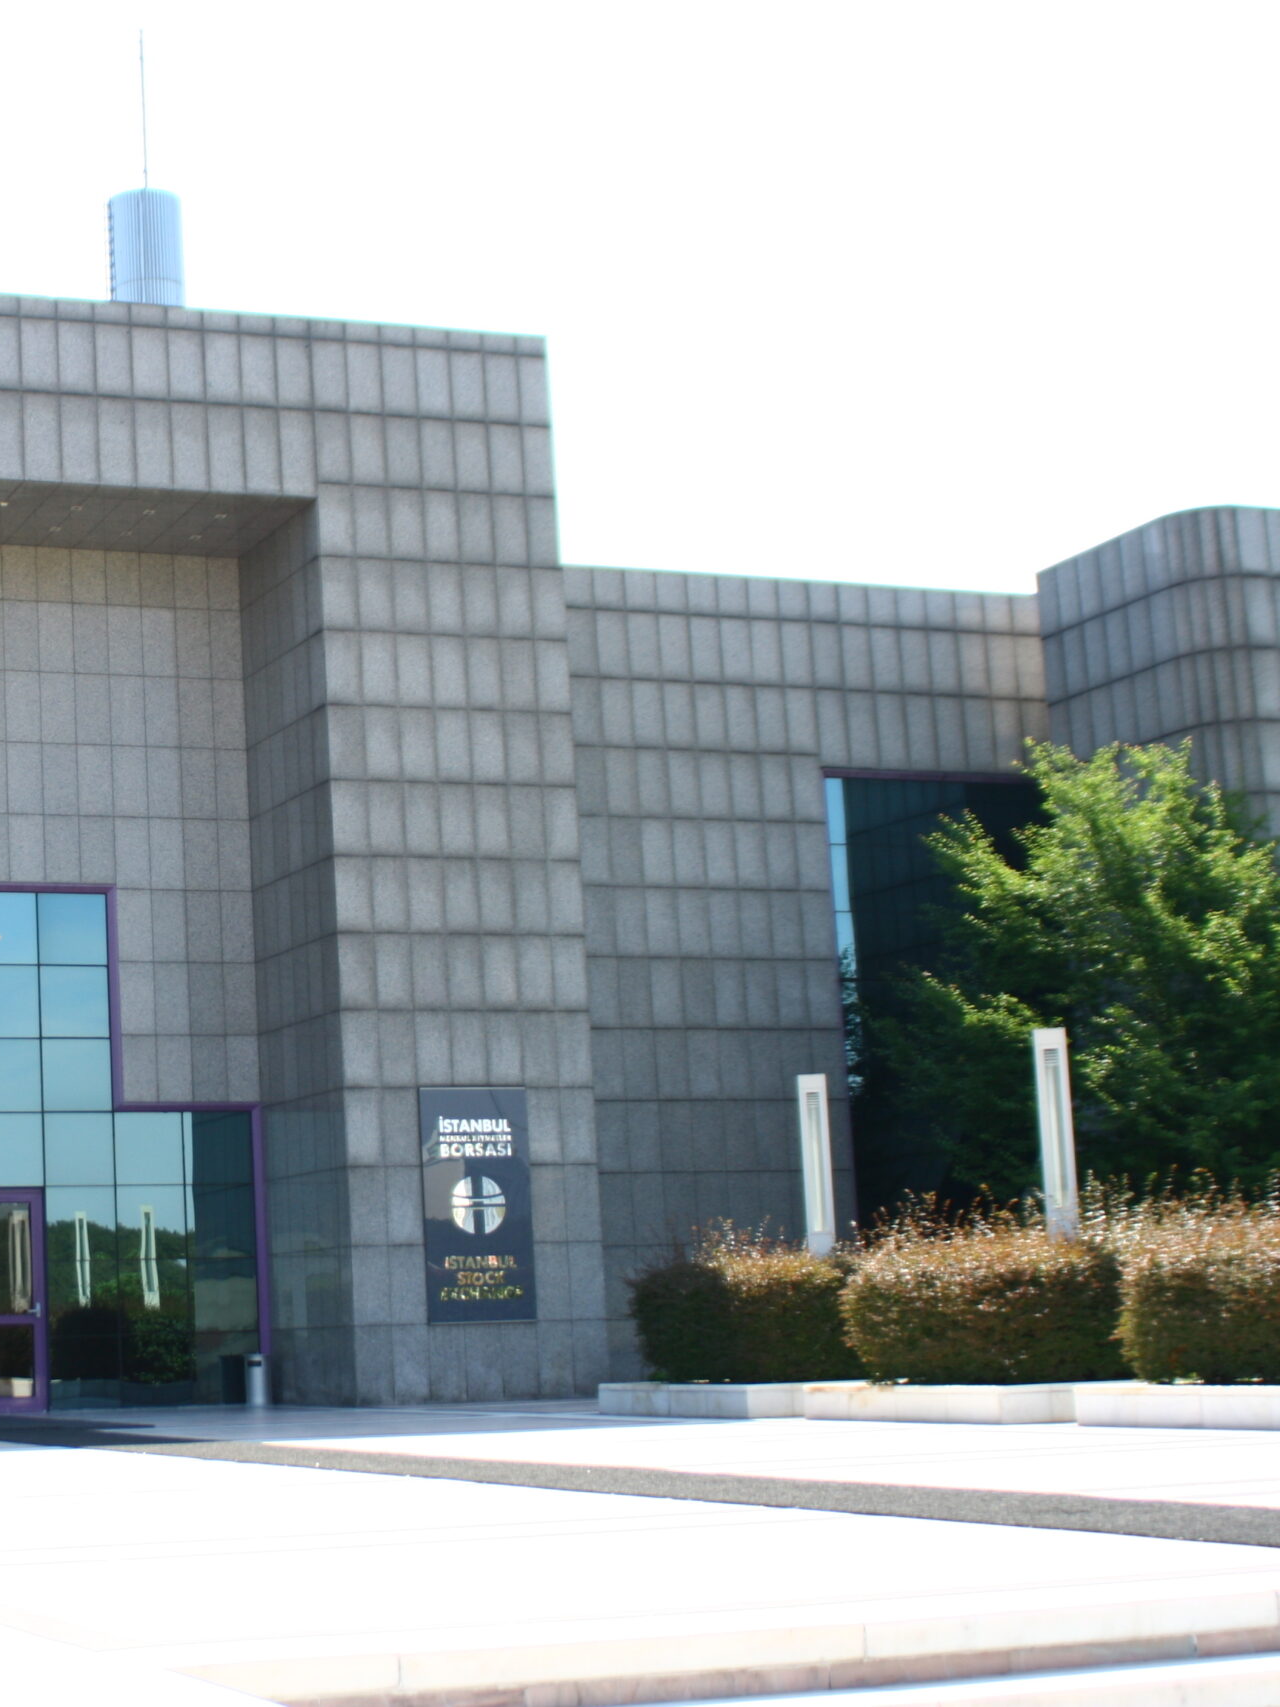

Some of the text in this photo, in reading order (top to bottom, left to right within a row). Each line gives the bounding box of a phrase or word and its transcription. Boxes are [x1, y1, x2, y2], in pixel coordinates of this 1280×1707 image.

[439, 1116, 511, 1133] İSTANBUL
[439, 1143, 512, 1157] BORSASI
[457, 1270, 505, 1285] STOCK
